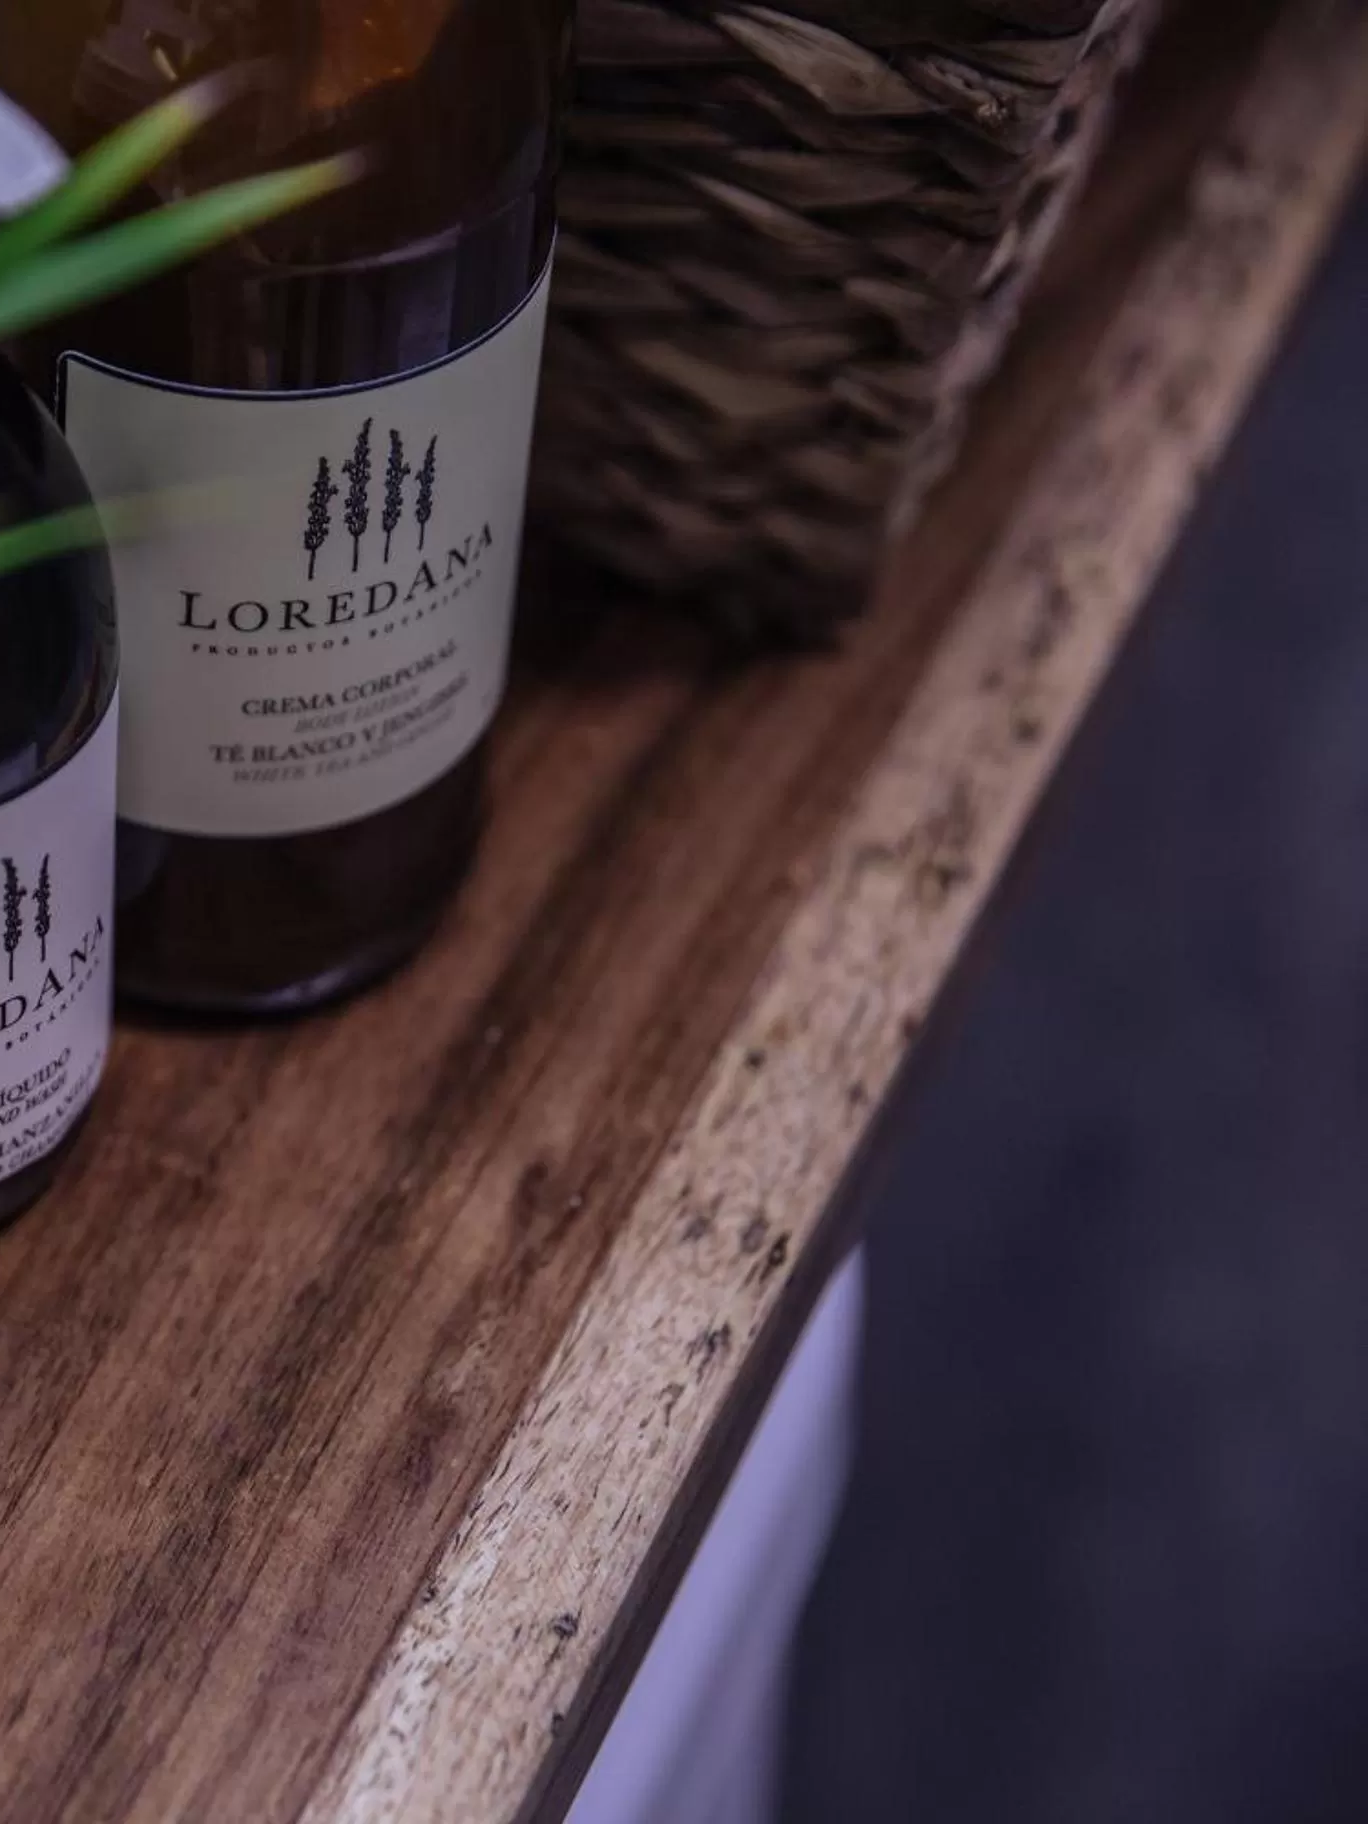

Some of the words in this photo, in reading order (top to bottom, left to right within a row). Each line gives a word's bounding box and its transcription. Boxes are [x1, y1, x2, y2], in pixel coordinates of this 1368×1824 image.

[177, 521, 493, 632] LOREDANA
[192, 635, 350, 656] PRODUCTOS
[241, 692, 336, 716] CREMA
[209, 743, 245, 763] TÉ
[251, 731, 357, 763] BLANCO
[361, 724, 379, 743] Y
